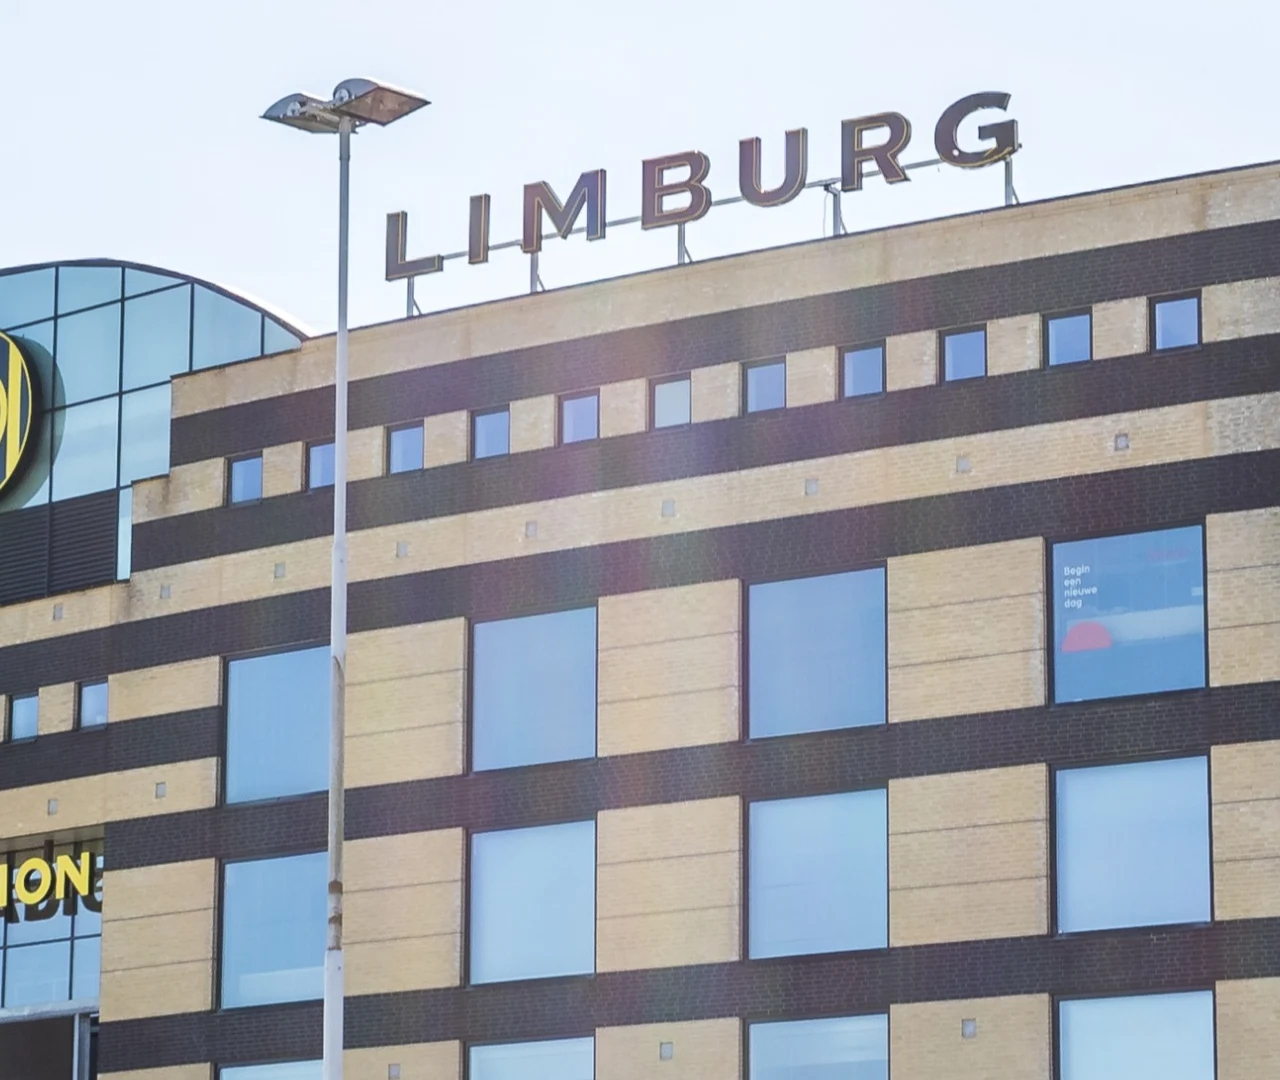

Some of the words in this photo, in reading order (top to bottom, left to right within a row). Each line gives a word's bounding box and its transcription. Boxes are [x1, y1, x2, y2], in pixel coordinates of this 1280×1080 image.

[385, 91, 1020, 281] LIMBURG
[1064, 564, 1091, 576] Begin
[1064, 578, 1081, 587] een
[1064, 586, 1098, 598] nieuwe
[1064, 598, 1082, 610] dag
